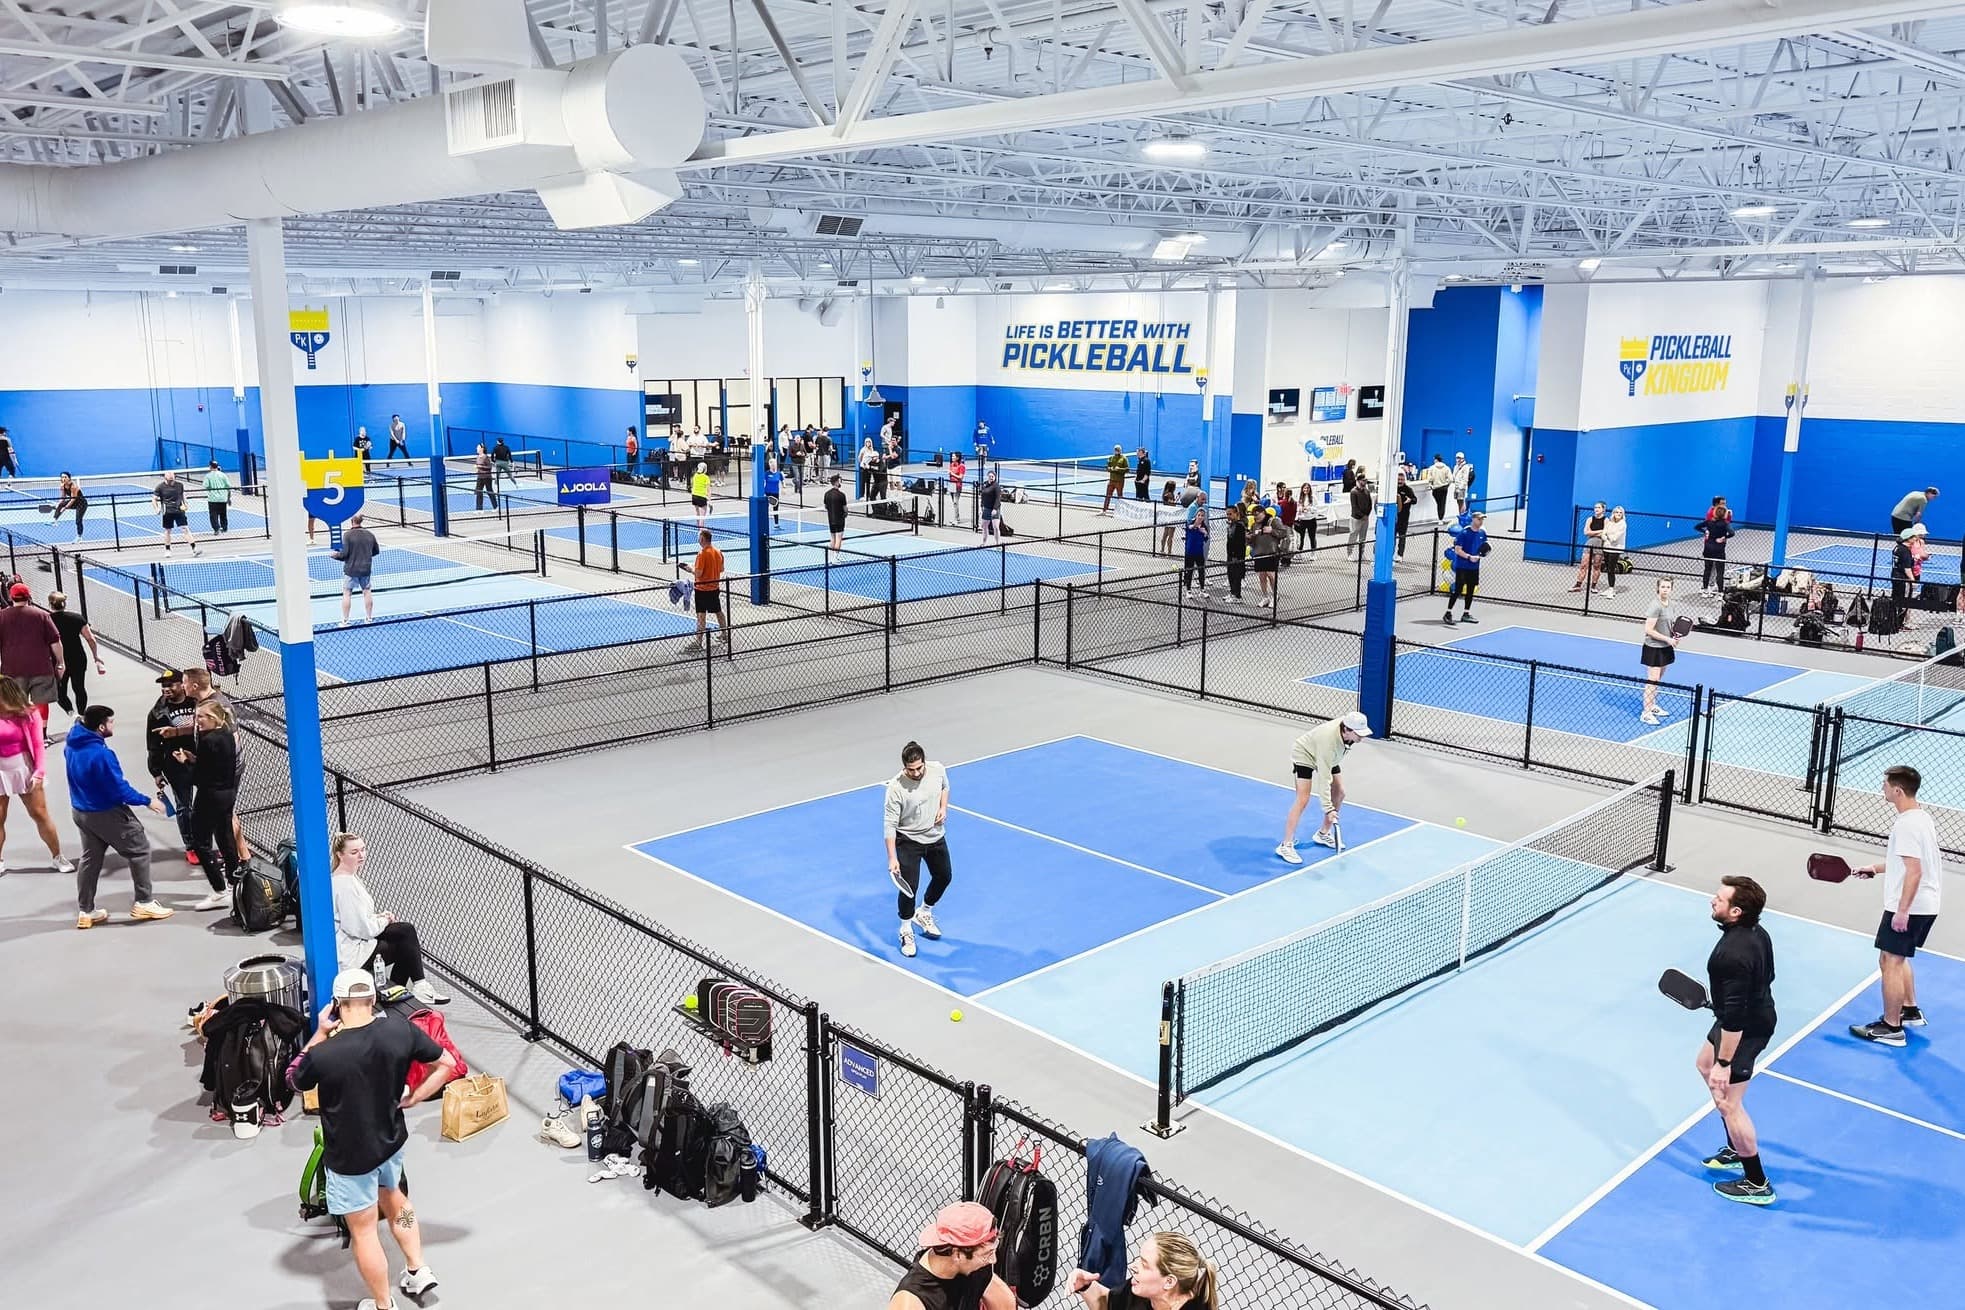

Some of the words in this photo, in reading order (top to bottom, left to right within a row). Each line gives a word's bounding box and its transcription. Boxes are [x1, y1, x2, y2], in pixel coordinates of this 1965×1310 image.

[295, 333, 307, 347] PK
[1006, 325, 1036, 339] LIFE
[1039, 325, 1054, 339] IS
[1057, 319, 1138, 339] BETTER
[1143, 323, 1191, 339] WITH
[1002, 341, 1193, 374] PICKLEBALL
[1650, 334, 1732, 361] PICKLEBALL
[1644, 361, 1731, 396] KINGDOM
[322, 471, 345, 505] 5
[570, 482, 608, 493] JOOLA
[843, 1057, 875, 1078] ADVANCED
[1038, 1206, 1053, 1262] CRBN
